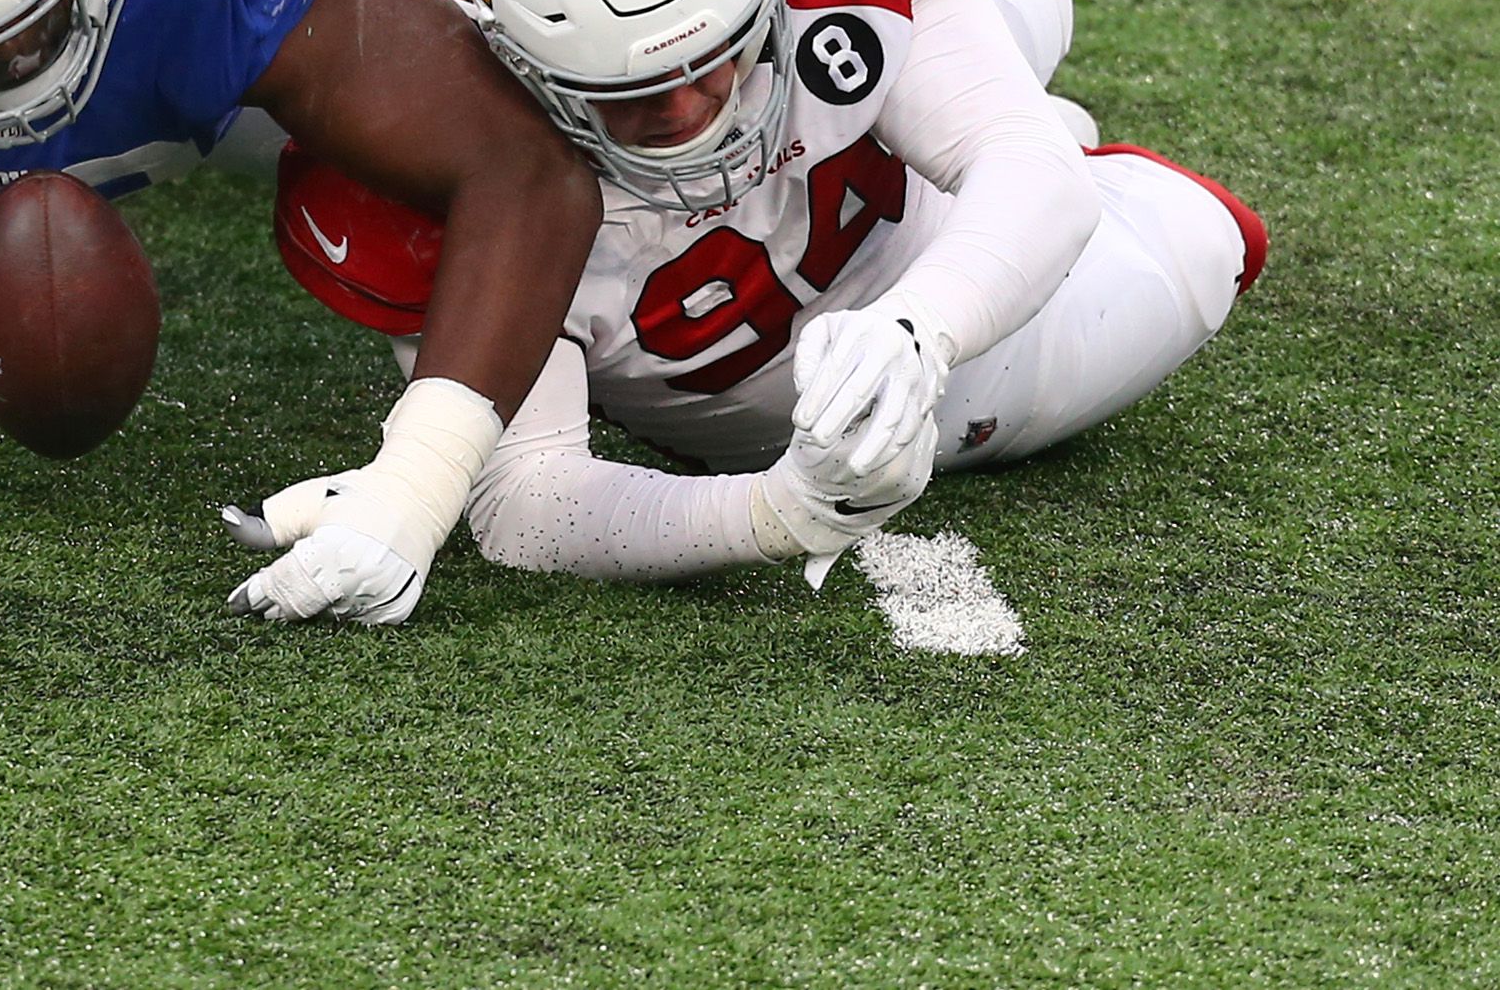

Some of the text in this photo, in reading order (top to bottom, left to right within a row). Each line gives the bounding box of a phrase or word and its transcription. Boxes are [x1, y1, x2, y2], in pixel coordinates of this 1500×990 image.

[644, 21, 707, 55] CARDINALS
[812, 24, 869, 93] 8
[685, 139, 806, 229] CAALS
[630, 131, 907, 396] 94
